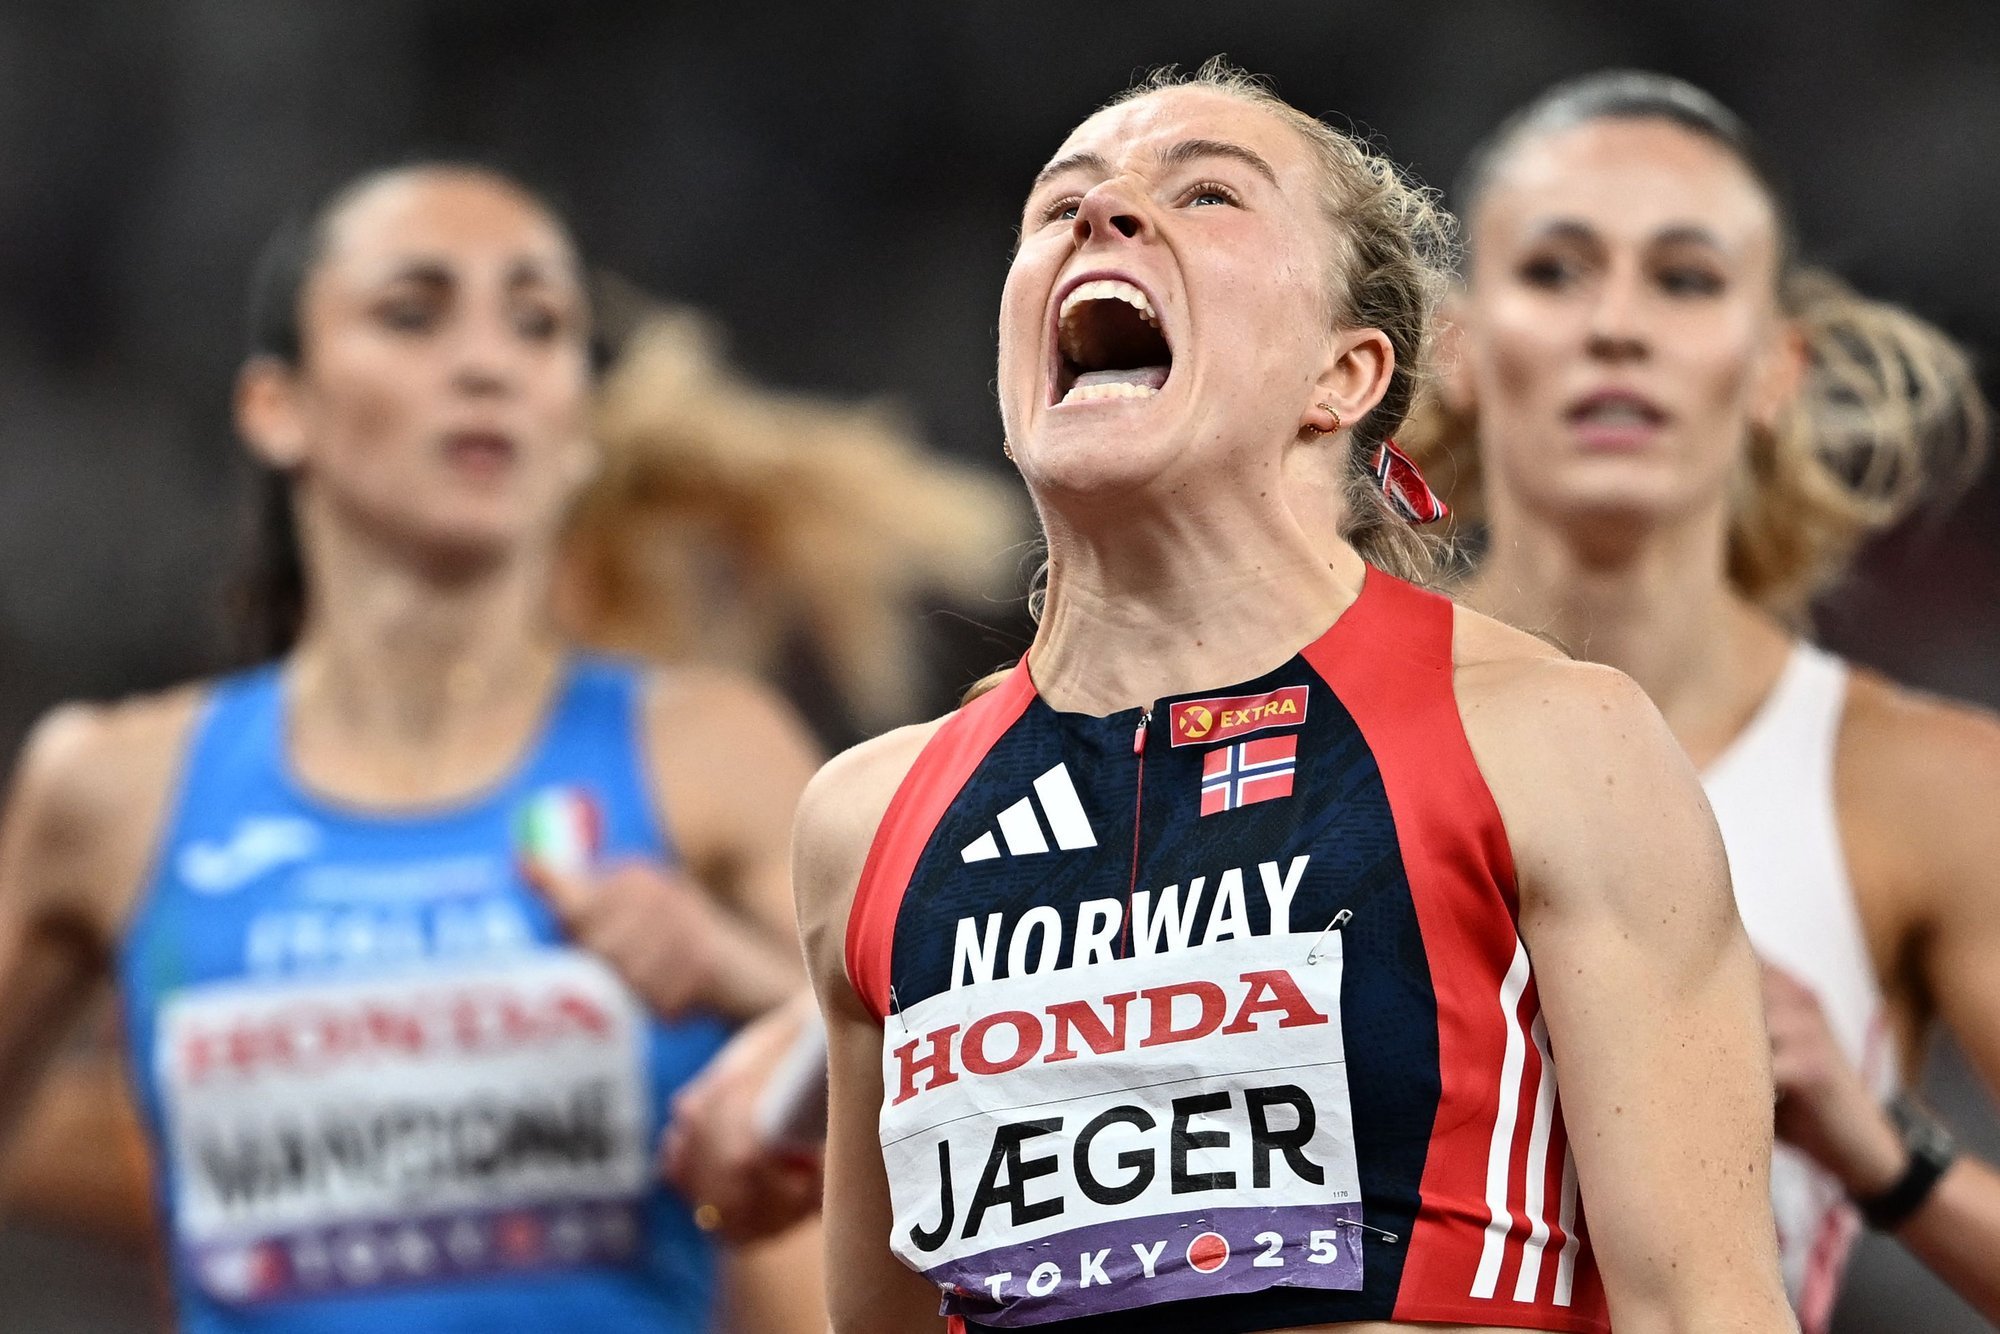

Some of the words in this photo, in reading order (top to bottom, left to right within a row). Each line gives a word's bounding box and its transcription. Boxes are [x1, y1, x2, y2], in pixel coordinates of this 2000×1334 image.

[1220, 698, 1297, 729] EXTRA
[949, 855, 1310, 991] NORWAY
[891, 969, 1329, 1107] HONDA
[909, 1083, 1326, 1253] JÆGER
[1252, 1229, 1339, 1269] 25
